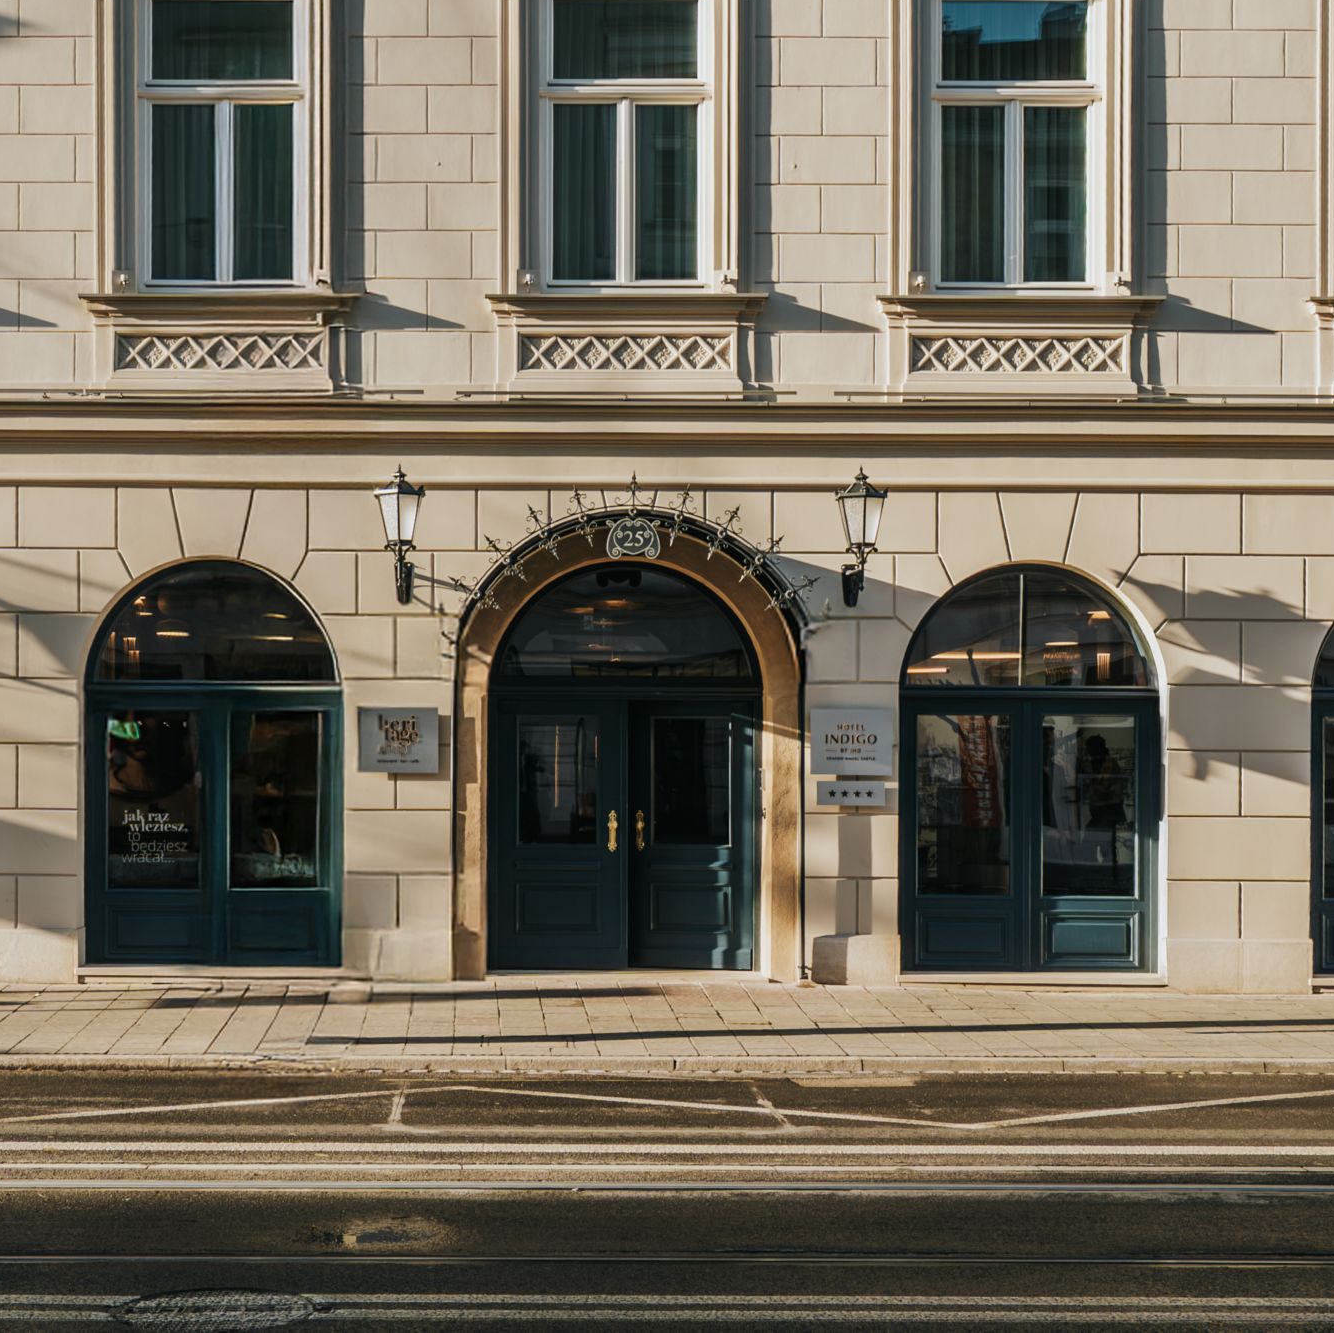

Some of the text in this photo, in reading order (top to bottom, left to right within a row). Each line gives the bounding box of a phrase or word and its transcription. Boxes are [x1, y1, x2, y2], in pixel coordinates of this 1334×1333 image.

[623, 530, 644, 547] 25
[825, 733, 878, 745] INDIGO
[122, 809, 169, 825] jak raz
[128, 831, 141, 842] to
[132, 839, 188, 854] będziesz
